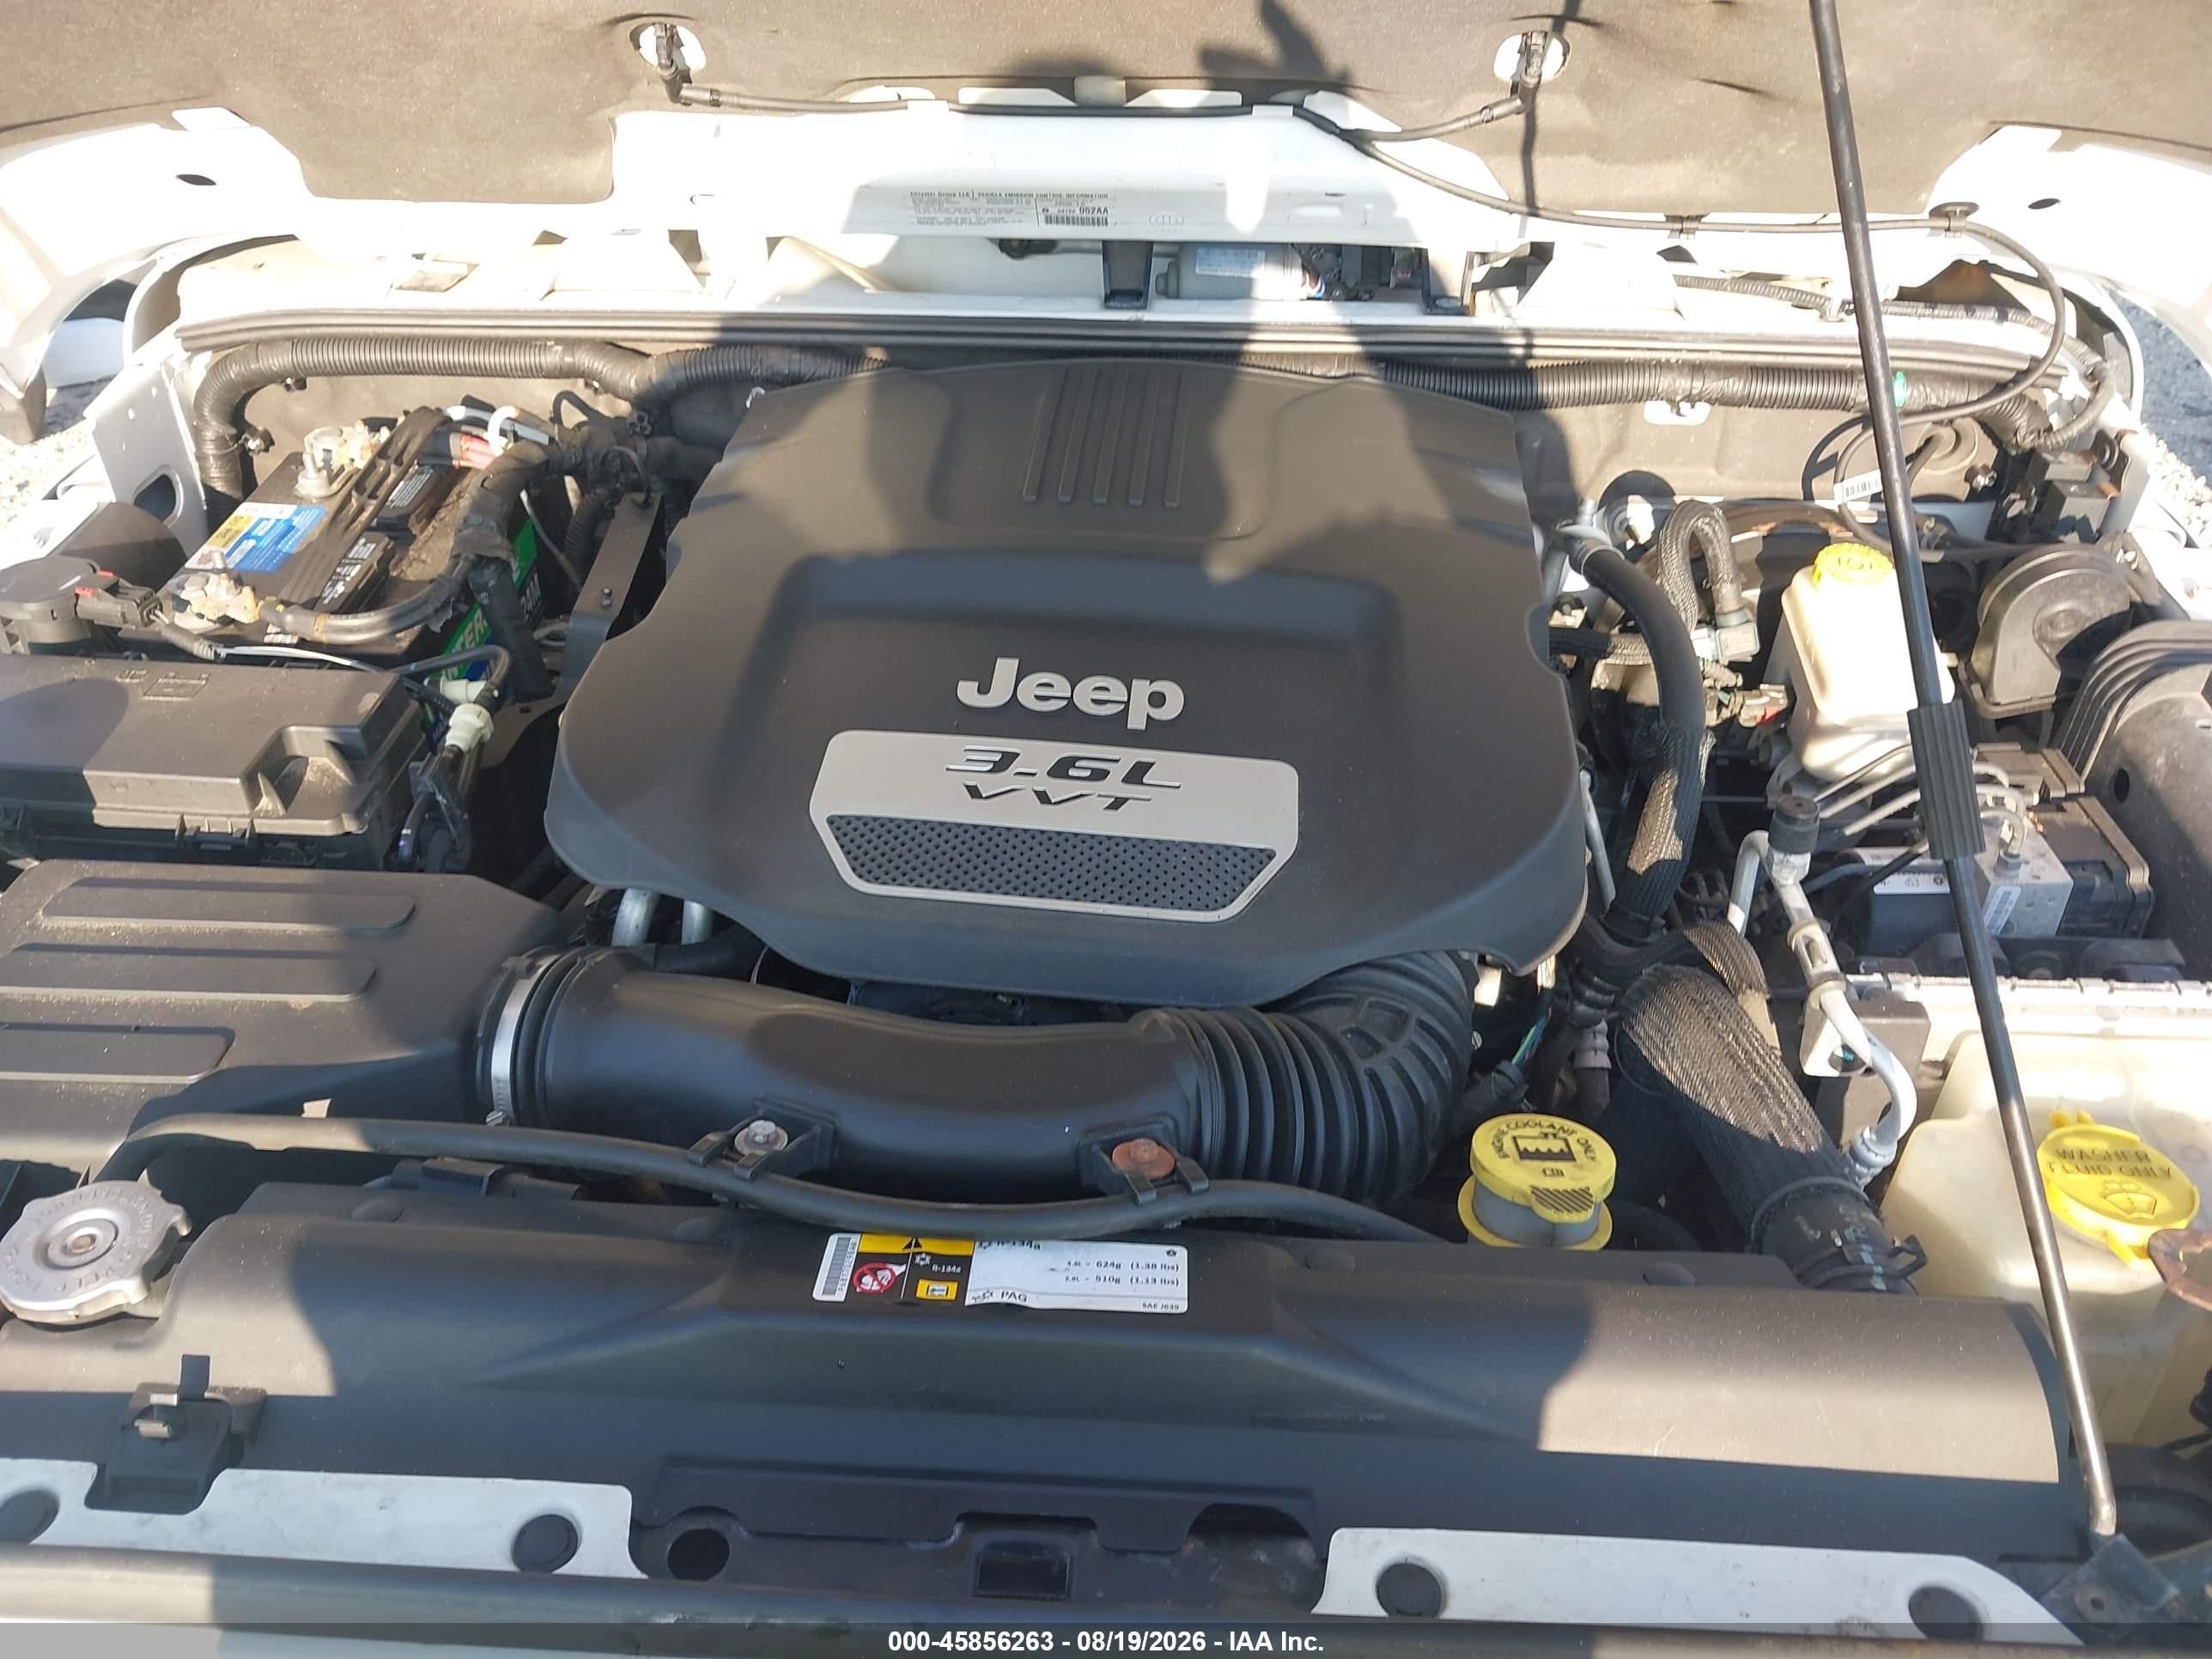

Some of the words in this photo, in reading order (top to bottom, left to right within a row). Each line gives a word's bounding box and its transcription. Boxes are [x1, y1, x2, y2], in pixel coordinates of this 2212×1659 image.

[957, 656, 1185, 730] Jeep
[945, 744, 1182, 789] 3.6L
[963, 781, 1152, 811] VVT
[1506, 1119, 1578, 1136] COOLANT
[1576, 1136, 1598, 1163] ONLY
[2055, 1147, 2151, 1164] WASHER
[2047, 1161, 2112, 1176] FLUID
[2118, 1164, 2172, 1180] ONLY
[1096, 1260, 1121, 1270] 624g
[1160, 1262, 1180, 1273] lbs)
[1095, 1275, 1121, 1285] 510g
[1160, 1277, 1180, 1287] lbs)
[1000, 1291, 1028, 1303] PAG
